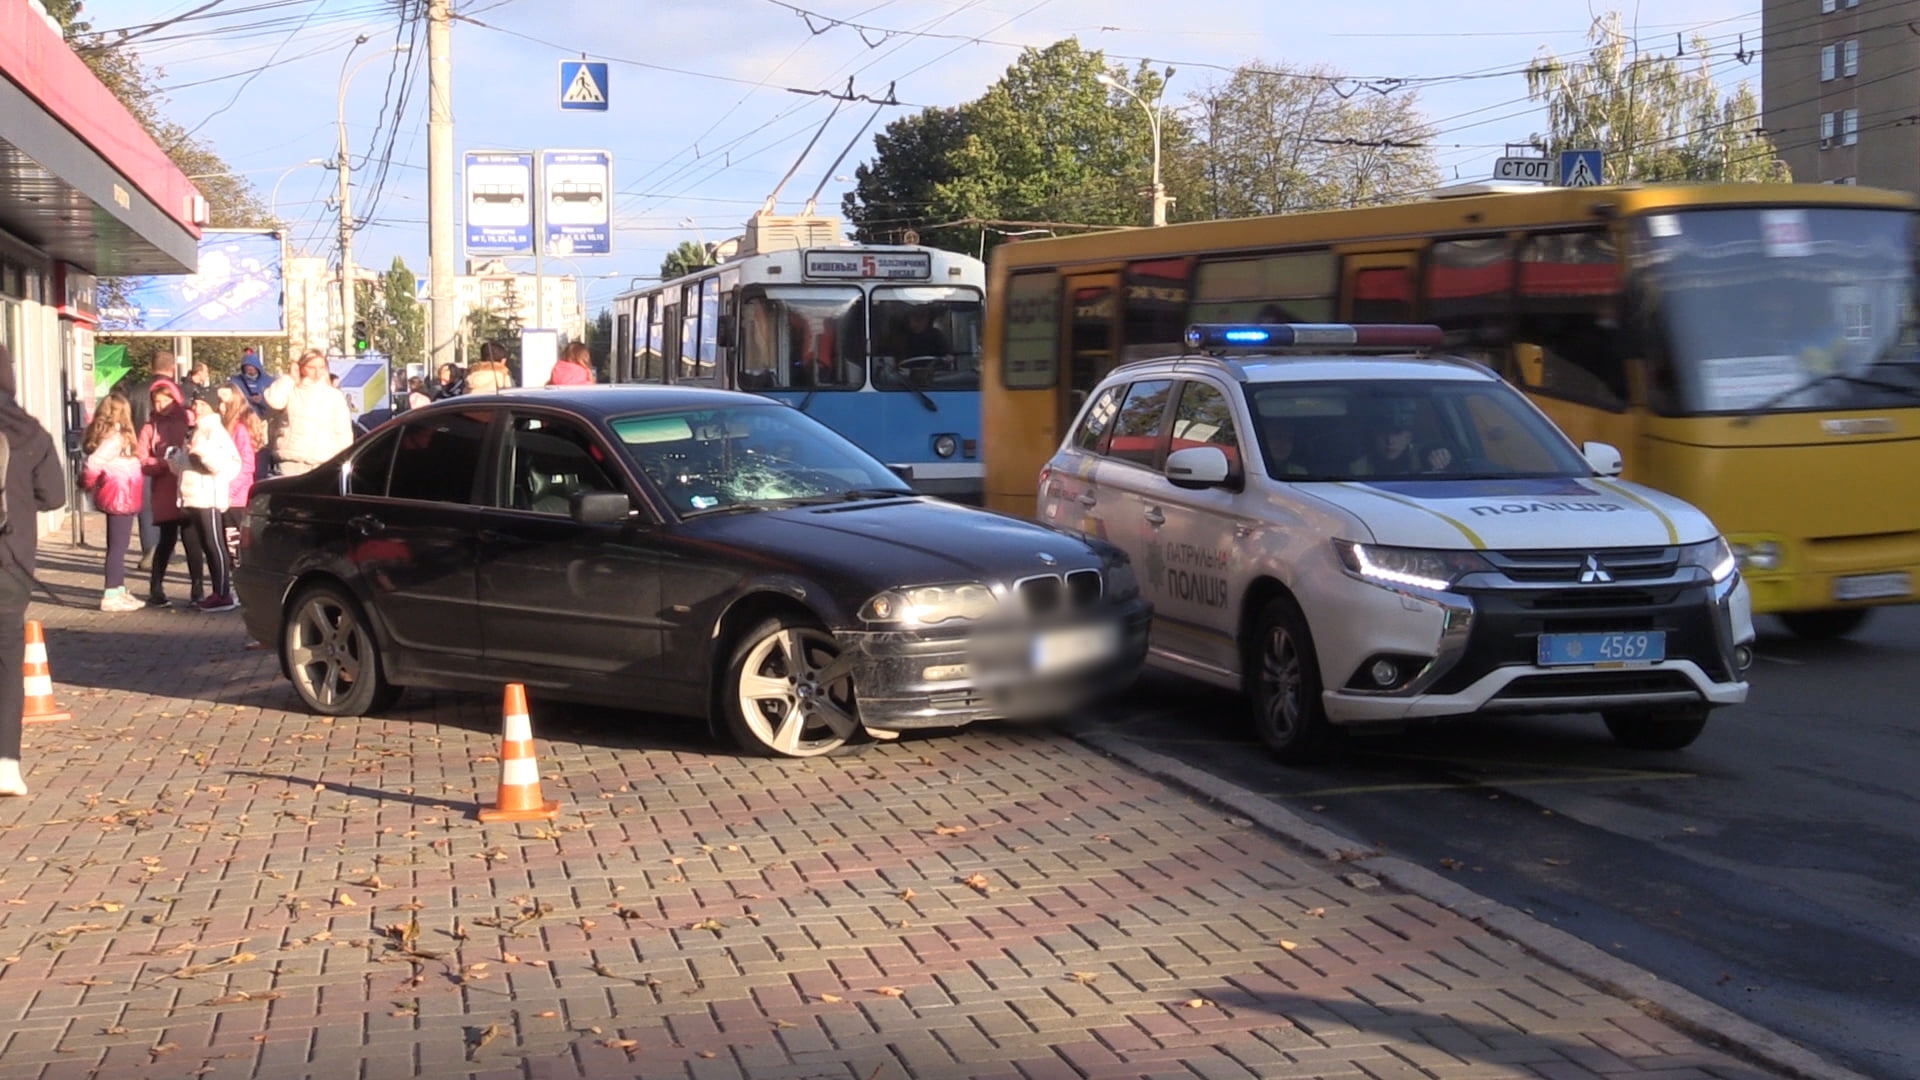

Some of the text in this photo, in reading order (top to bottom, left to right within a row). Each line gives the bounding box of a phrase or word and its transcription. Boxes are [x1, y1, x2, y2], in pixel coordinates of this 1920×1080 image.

[1501, 161, 1549, 178] СТОП
[862, 255, 876, 277] 5
[1469, 502, 1625, 516] ПОЛІЦІЯ
[1168, 568, 1229, 609] ПОЛІЦІЯ
[1600, 635, 1648, 659] 4569
